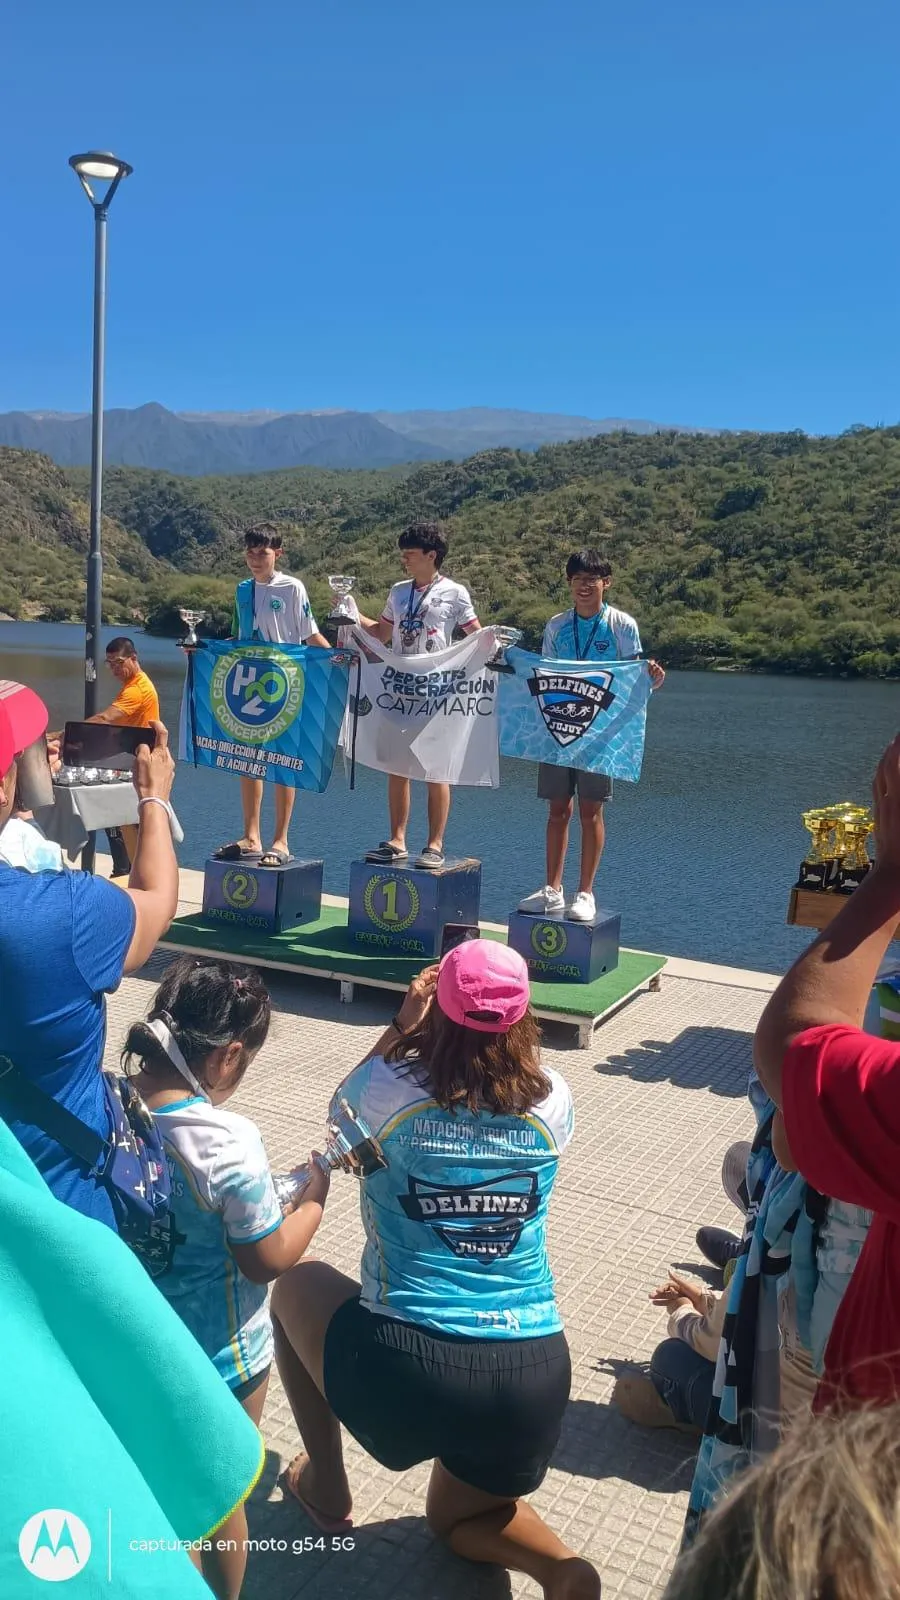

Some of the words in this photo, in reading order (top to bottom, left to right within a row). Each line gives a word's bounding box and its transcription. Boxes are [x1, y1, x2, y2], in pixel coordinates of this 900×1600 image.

[538, 678, 605, 702] DELFINES
[376, 693, 493, 717] CATAMARC
[550, 721, 583, 735] JUJUY
[216, 755, 227, 768] DE
[257, 749, 267, 762] DE
[267, 751, 305, 772] DEPORTES
[233, 874, 249, 901] 2
[382, 880, 399, 921] 1
[541, 926, 558, 951] 3
[418, 1195, 530, 1215] DELFINES
[455, 1241, 511, 1254] JUJUY
